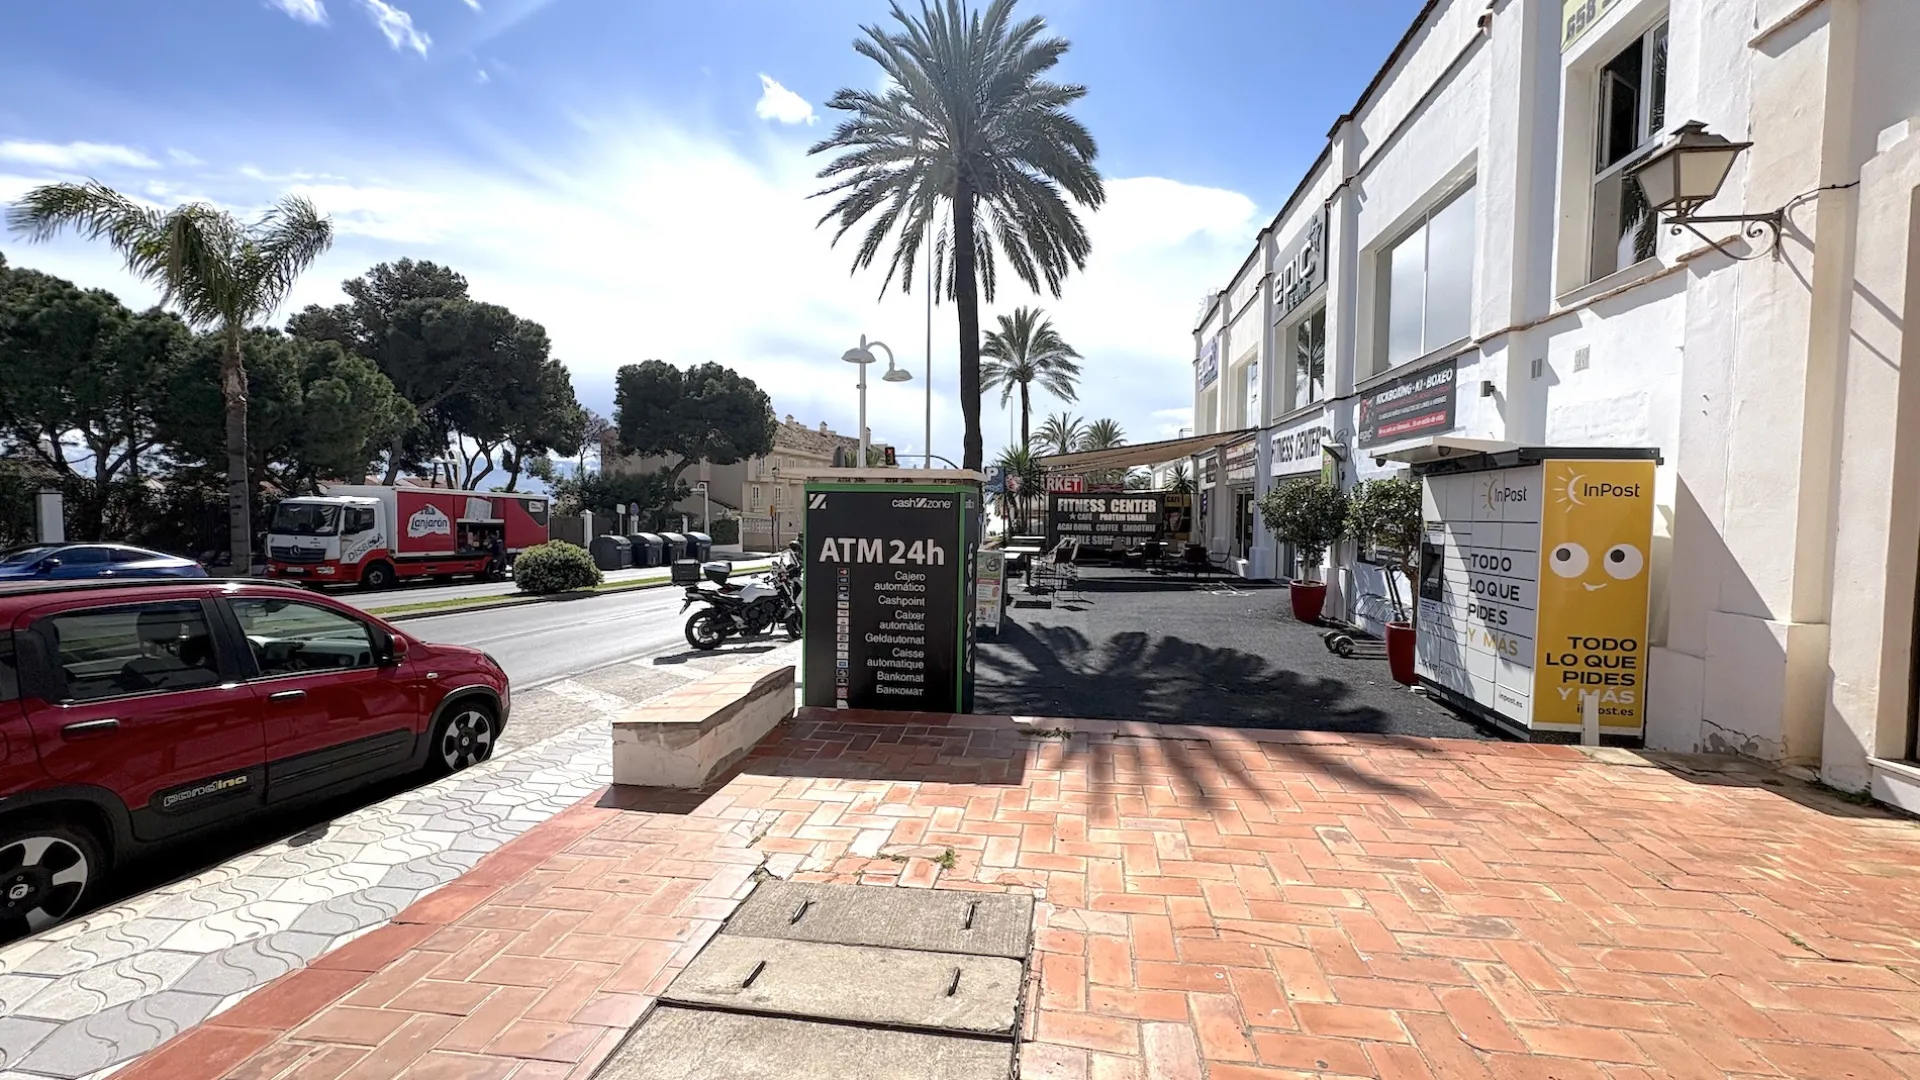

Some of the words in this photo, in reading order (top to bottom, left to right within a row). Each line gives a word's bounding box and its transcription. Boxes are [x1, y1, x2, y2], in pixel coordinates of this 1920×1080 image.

[1045, 477, 1080, 491] RKET
[1583, 482, 1640, 498] InPost
[1494, 486, 1527, 502] InPost
[1057, 498, 1106, 513] FITNESS
[1111, 499, 1157, 513] CENTER
[411, 517, 448, 531] Lanjarón
[1073, 523, 1092, 531] BOWL
[1095, 523, 1119, 532] COFFEE
[819, 537, 884, 564] ATM
[889, 538, 945, 566] 24h
[1470, 553, 1512, 572] TODO
[894, 570, 926, 582] Cajero
[874, 581, 926, 592] automático
[878, 595, 926, 607] Cashpoint
[895, 610, 925, 620] Caixer
[1468, 603, 1508, 626] PIDES
[865, 632, 925, 645] Geldautomat
[1468, 627, 1476, 642] Y
[1567, 636, 1638, 651] TODO
[892, 647, 924, 658] Caisse
[867, 658, 924, 670] automatique
[1546, 653, 1578, 667] LO
[1584, 653, 1637, 670] QUE
[877, 671, 924, 682] Bankomat
[1562, 670, 1636, 687] PIDES
[876, 684, 924, 696] Банкомат
[1557, 687, 1574, 701] Y
[1577, 703, 1634, 716] iost.es
